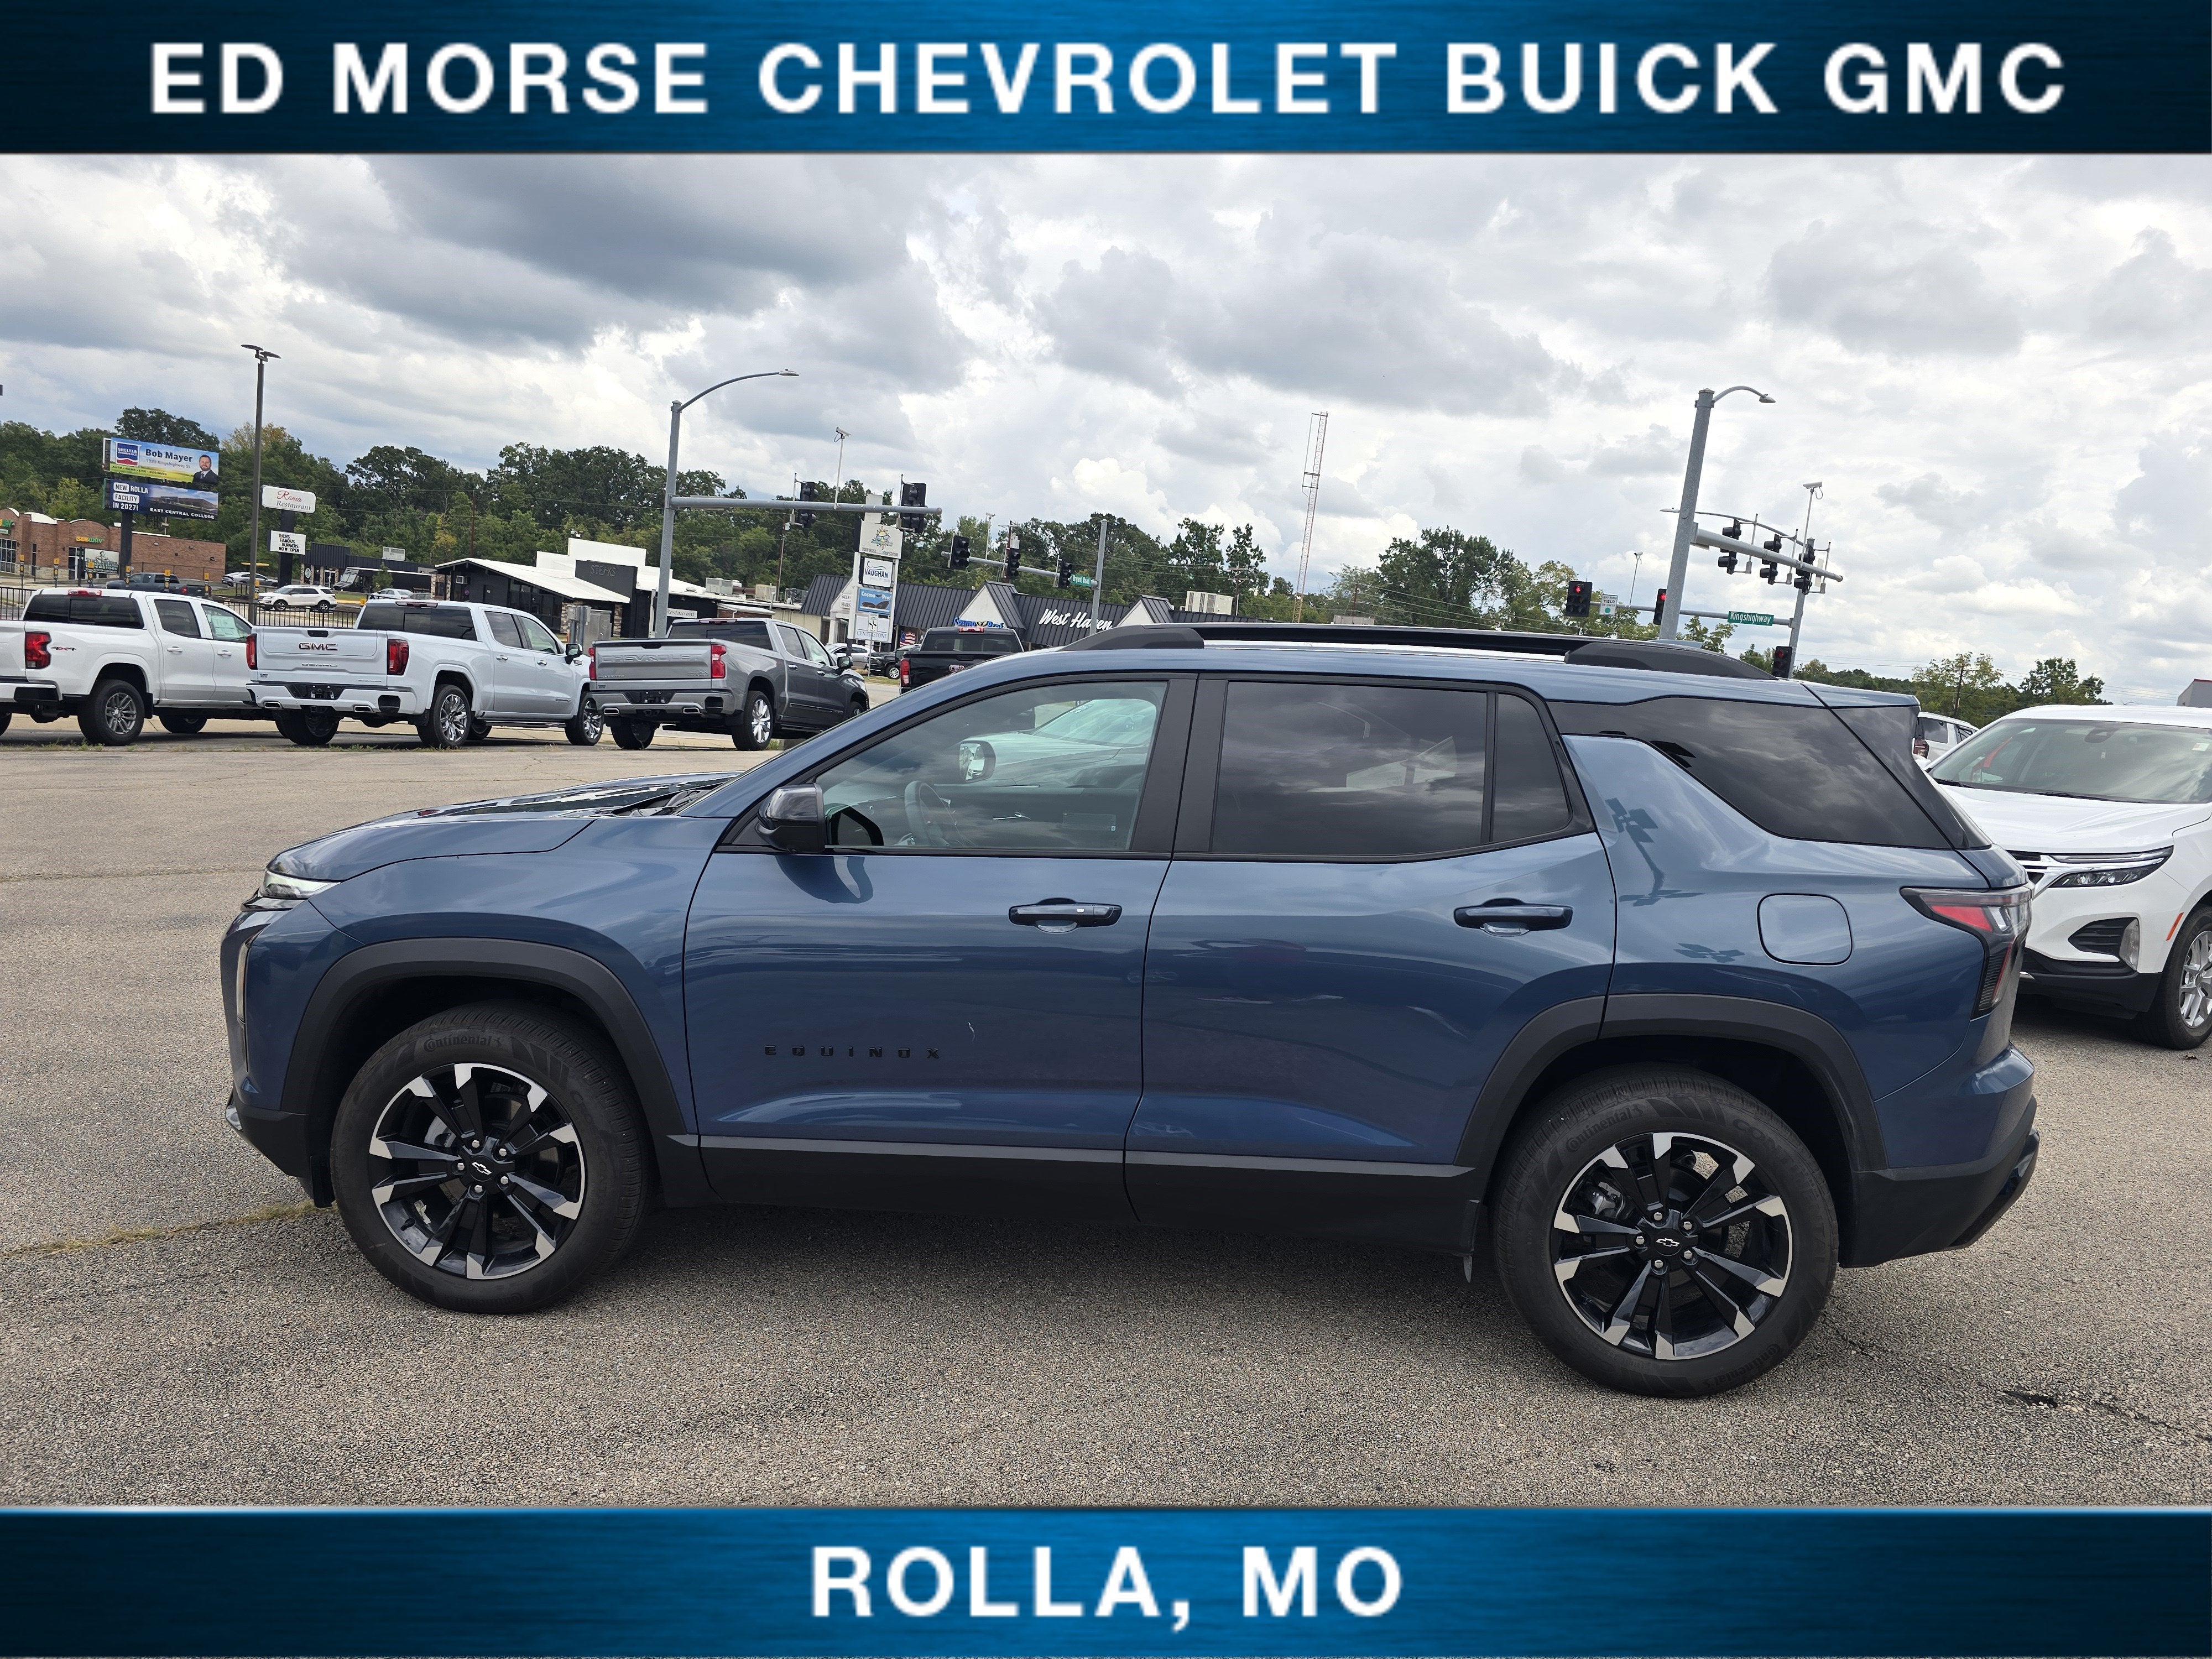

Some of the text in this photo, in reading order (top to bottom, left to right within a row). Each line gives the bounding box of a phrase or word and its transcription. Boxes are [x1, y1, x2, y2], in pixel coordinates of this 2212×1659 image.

[145, 448, 192, 462] Bob Mayer
[276, 500, 311, 510] Restaurant
[865, 568, 888, 578] VAUGHAN
[954, 615, 976, 627] Cosmo
[1039, 608, 1113, 630] West Haen
[1730, 612, 1771, 625] Kingshighway
[299, 643, 338, 651] GMC
[602, 654, 703, 662] CHEVROLET
[424, 1034, 492, 1052] Continental
[764, 1045, 940, 1059] EQUINOX
[1566, 1107, 1633, 1153] Continental
